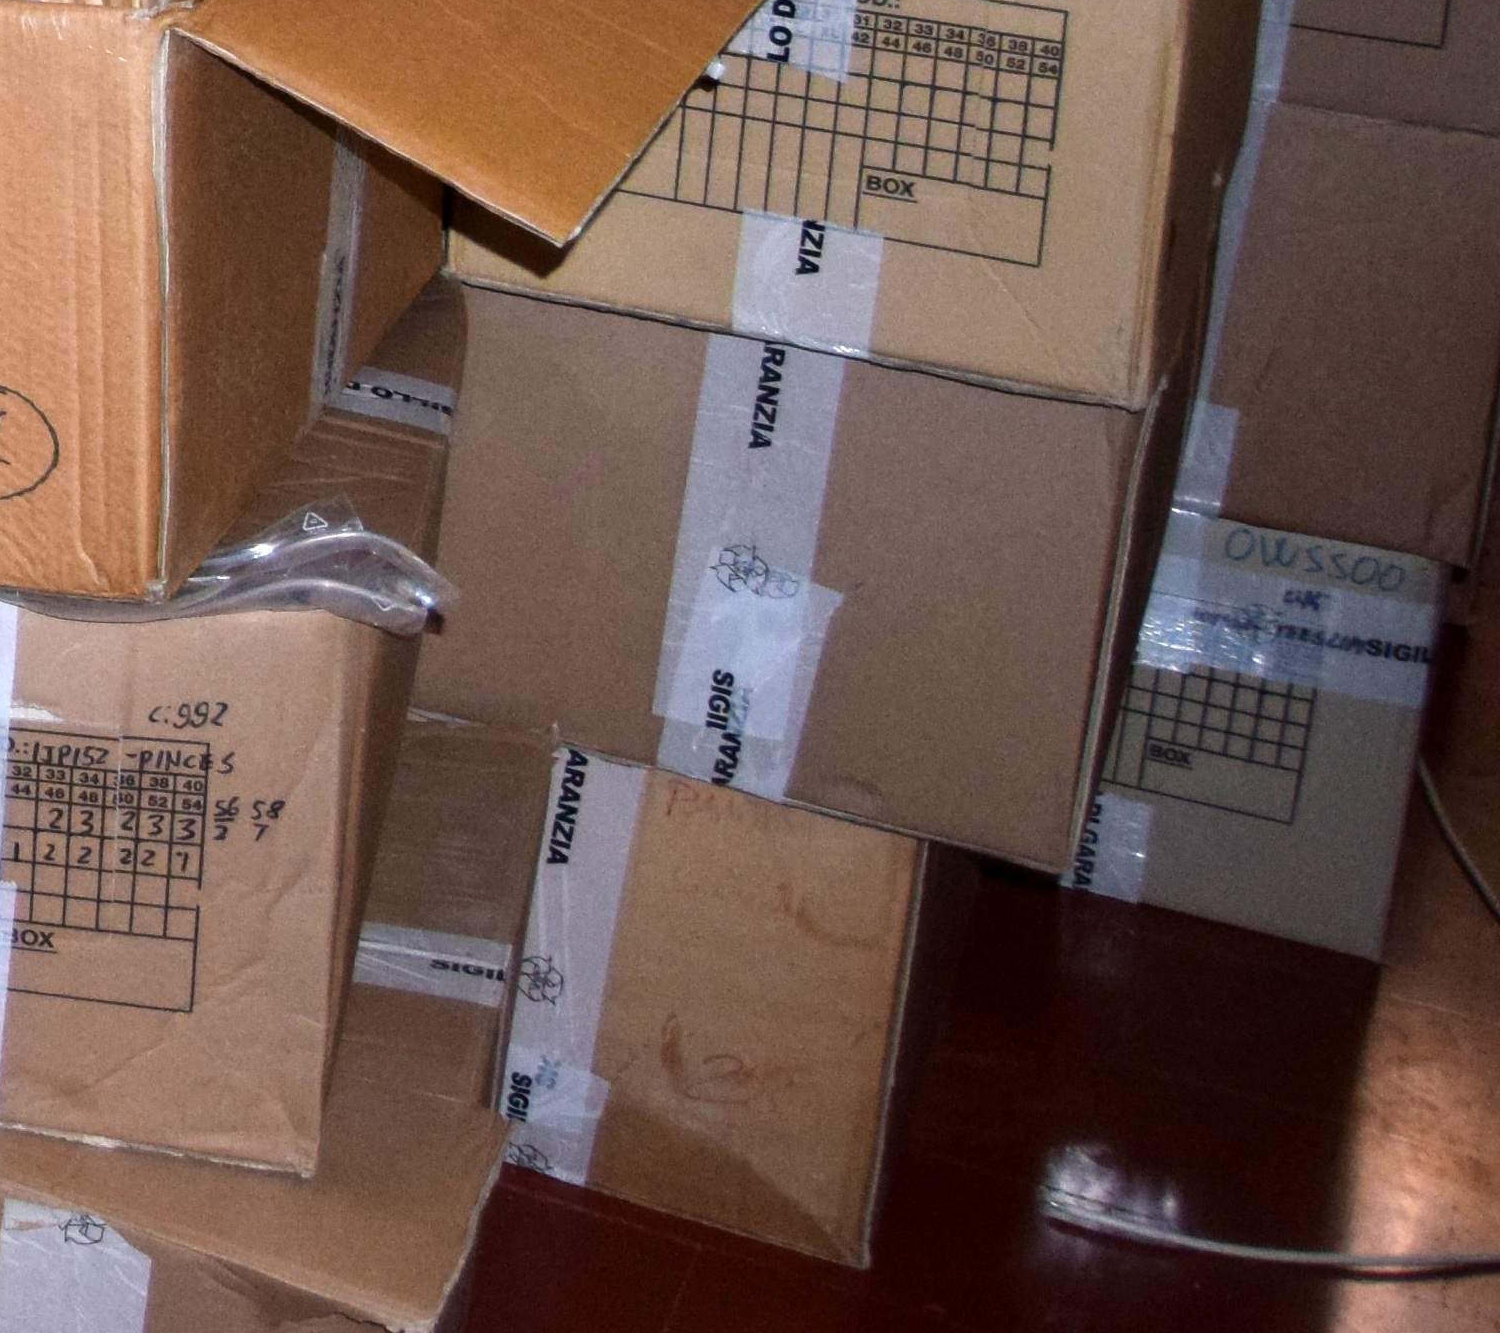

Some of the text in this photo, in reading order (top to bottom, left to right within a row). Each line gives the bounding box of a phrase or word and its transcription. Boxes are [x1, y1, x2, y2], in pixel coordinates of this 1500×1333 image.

[865, 174, 916, 198] BOX
[1149, 743, 1192, 765] BOX
[45, 768, 204, 793] 33 34 38 40
[43, 786, 203, 812] 46 48 52 54
[251, 799, 285, 821] 58
[47, 806, 196, 842] 2 3 2 3 3
[42, 840, 57, 862] 2
[76, 845, 92, 866] 2
[119, 844, 134, 866] 2
[139, 845, 156, 866] 2
